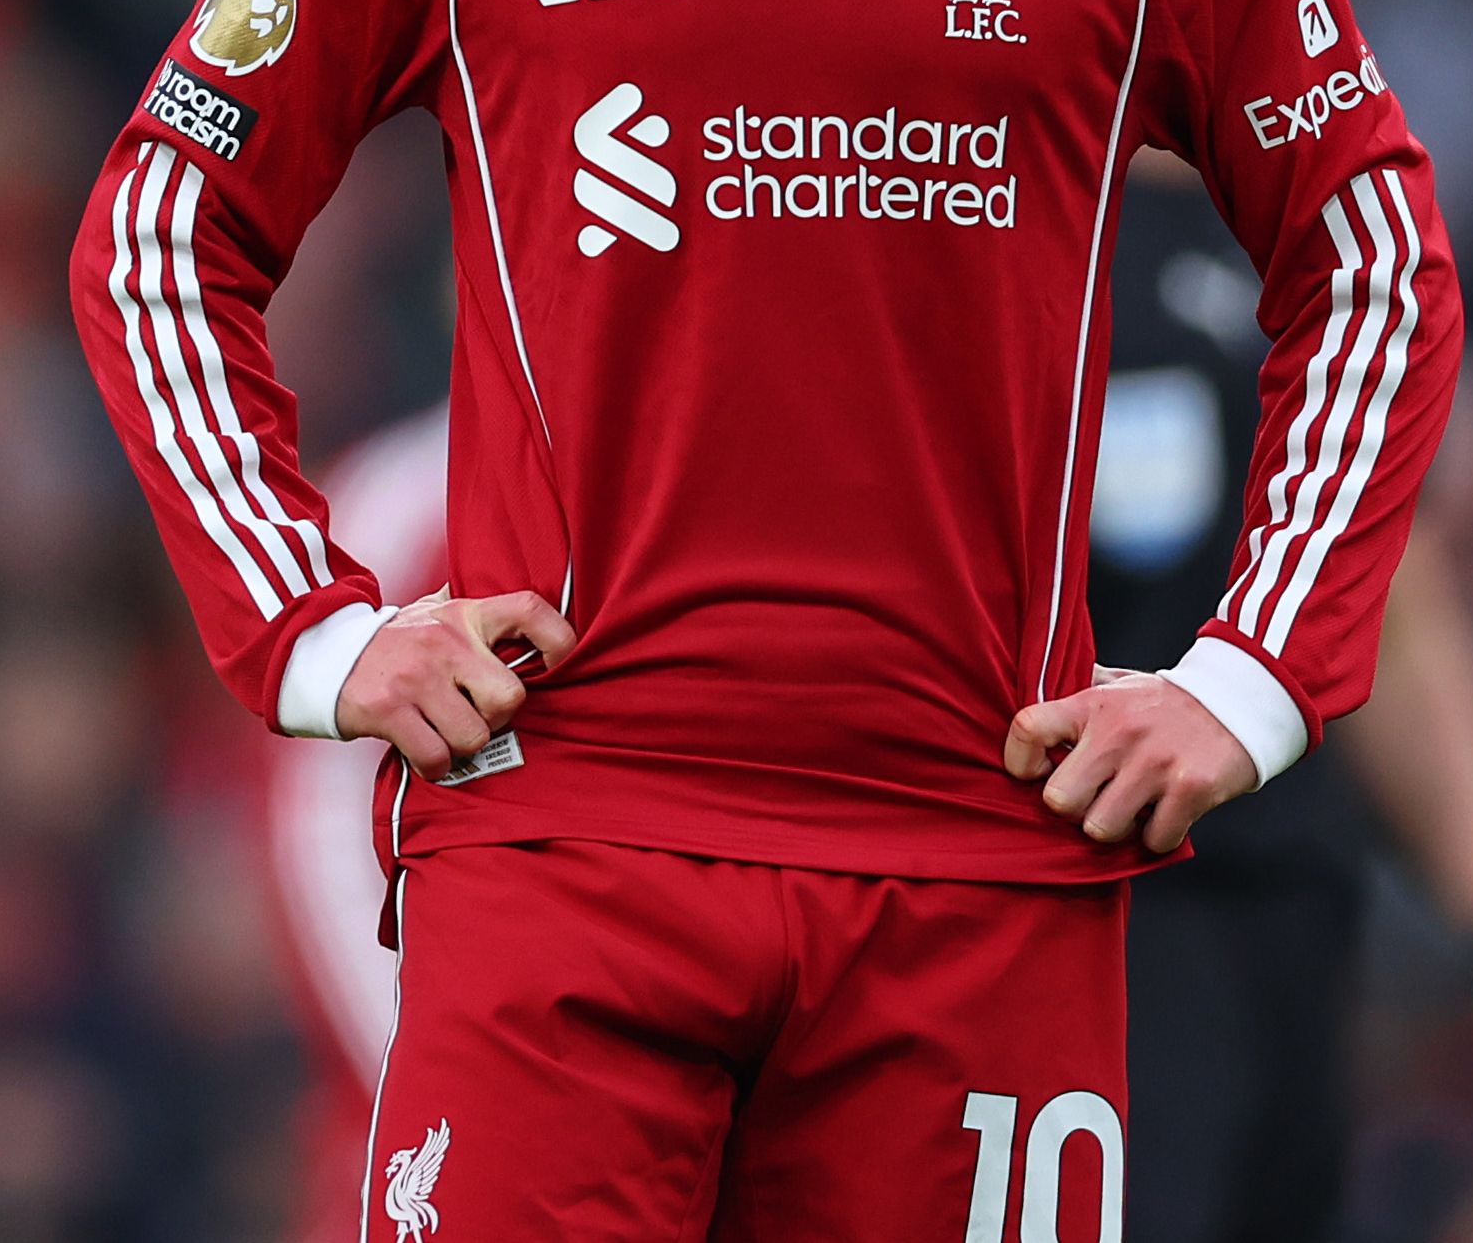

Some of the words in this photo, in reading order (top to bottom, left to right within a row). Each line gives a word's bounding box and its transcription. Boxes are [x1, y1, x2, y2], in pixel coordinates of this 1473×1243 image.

[945, 6, 1027, 43] L.F.C.
[150, 94, 240, 161] racism
[166, 71, 241, 131] room
[703, 105, 1007, 168] standard
[706, 164, 1016, 228] chartered
[962, 1091, 1124, 1243] 10
